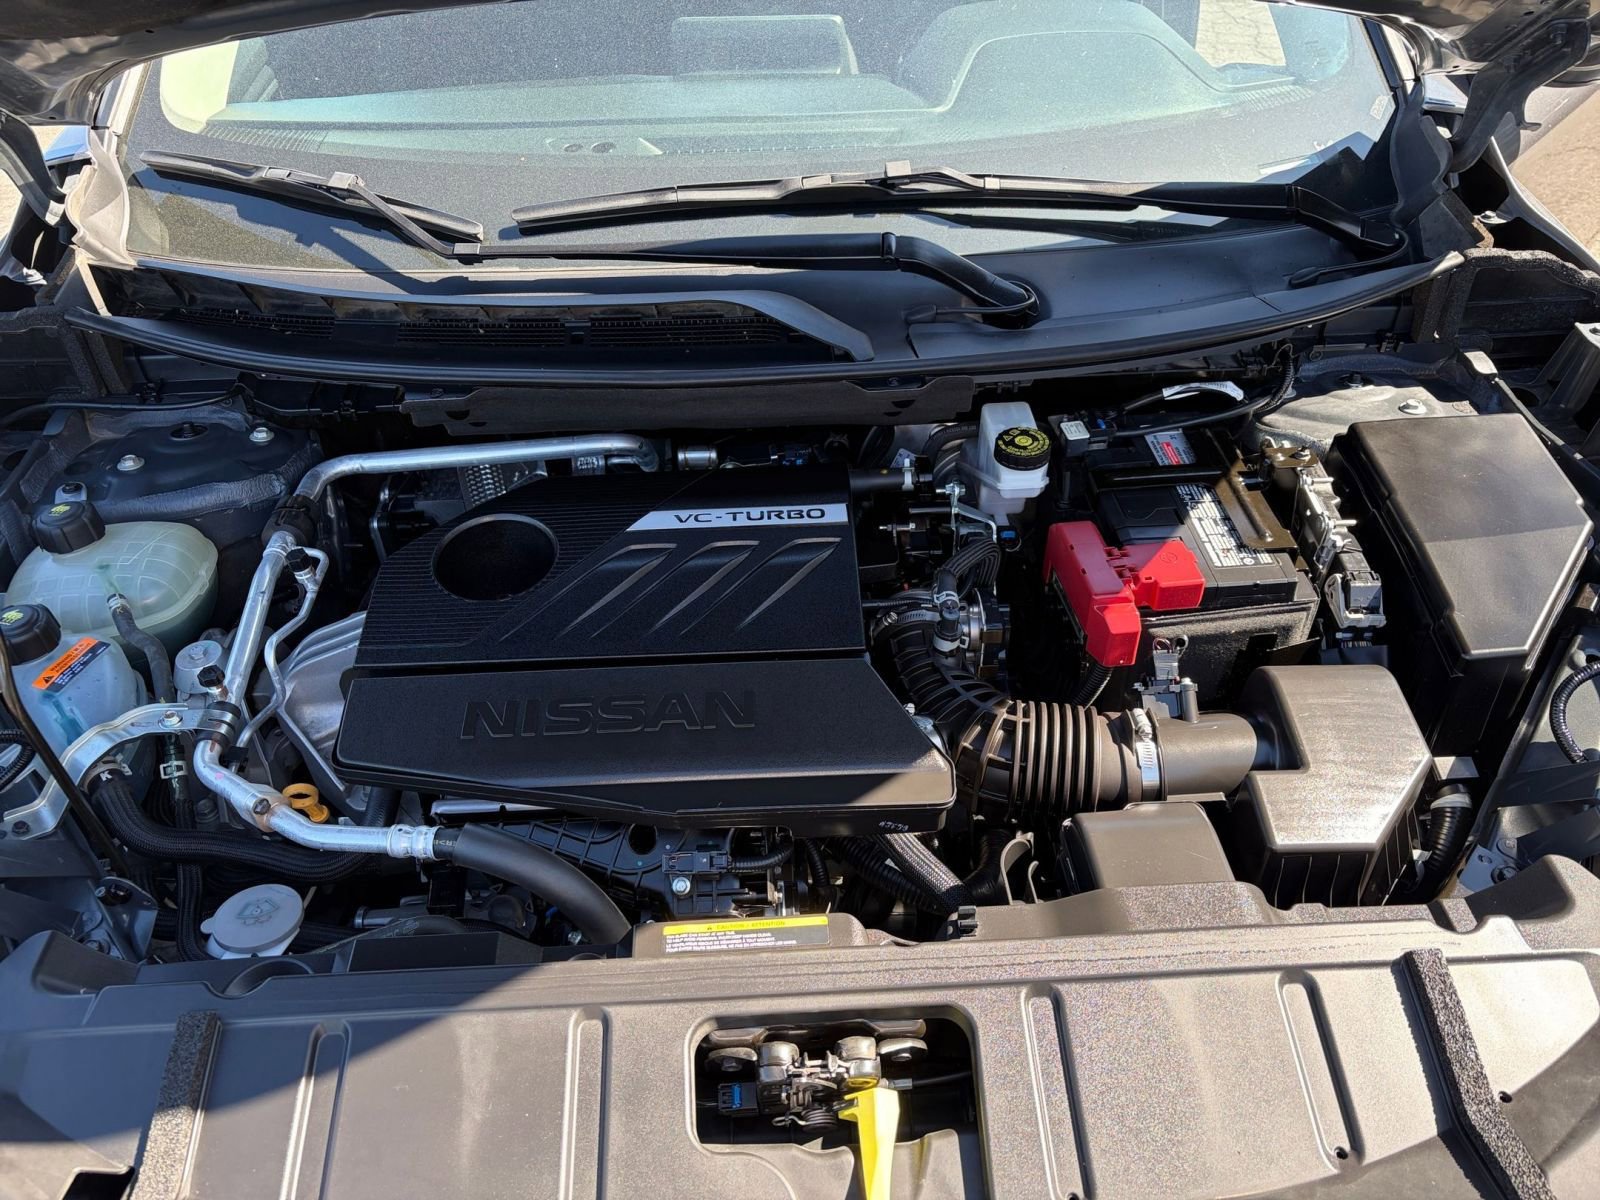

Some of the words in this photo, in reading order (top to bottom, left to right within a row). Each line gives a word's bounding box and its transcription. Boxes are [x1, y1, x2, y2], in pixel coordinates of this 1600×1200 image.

[674, 508, 826, 524] VC-TURBO
[460, 690, 756, 740] NISSAN
[100, 770, 113, 781] K
